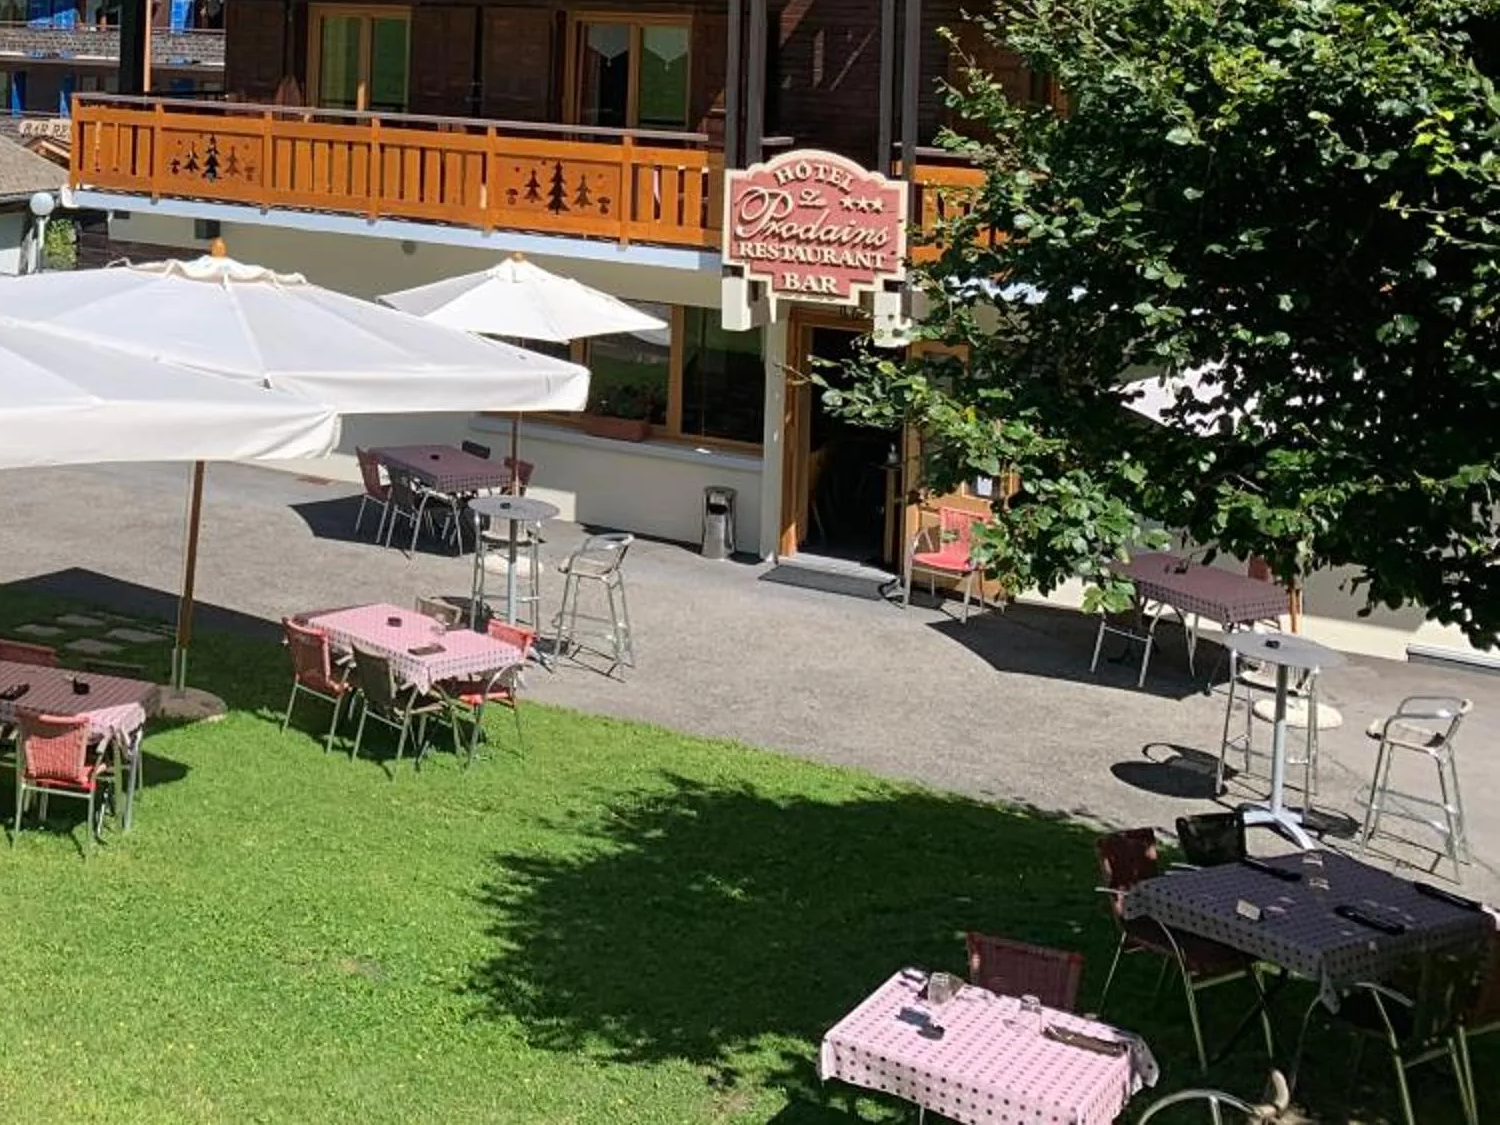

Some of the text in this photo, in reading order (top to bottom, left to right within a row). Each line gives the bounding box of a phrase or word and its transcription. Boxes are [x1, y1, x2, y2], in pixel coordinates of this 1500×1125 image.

[736, 186, 890, 246] Prodains
[739, 241, 885, 267] RESTAURANT
[783, 272, 838, 293] BAR
